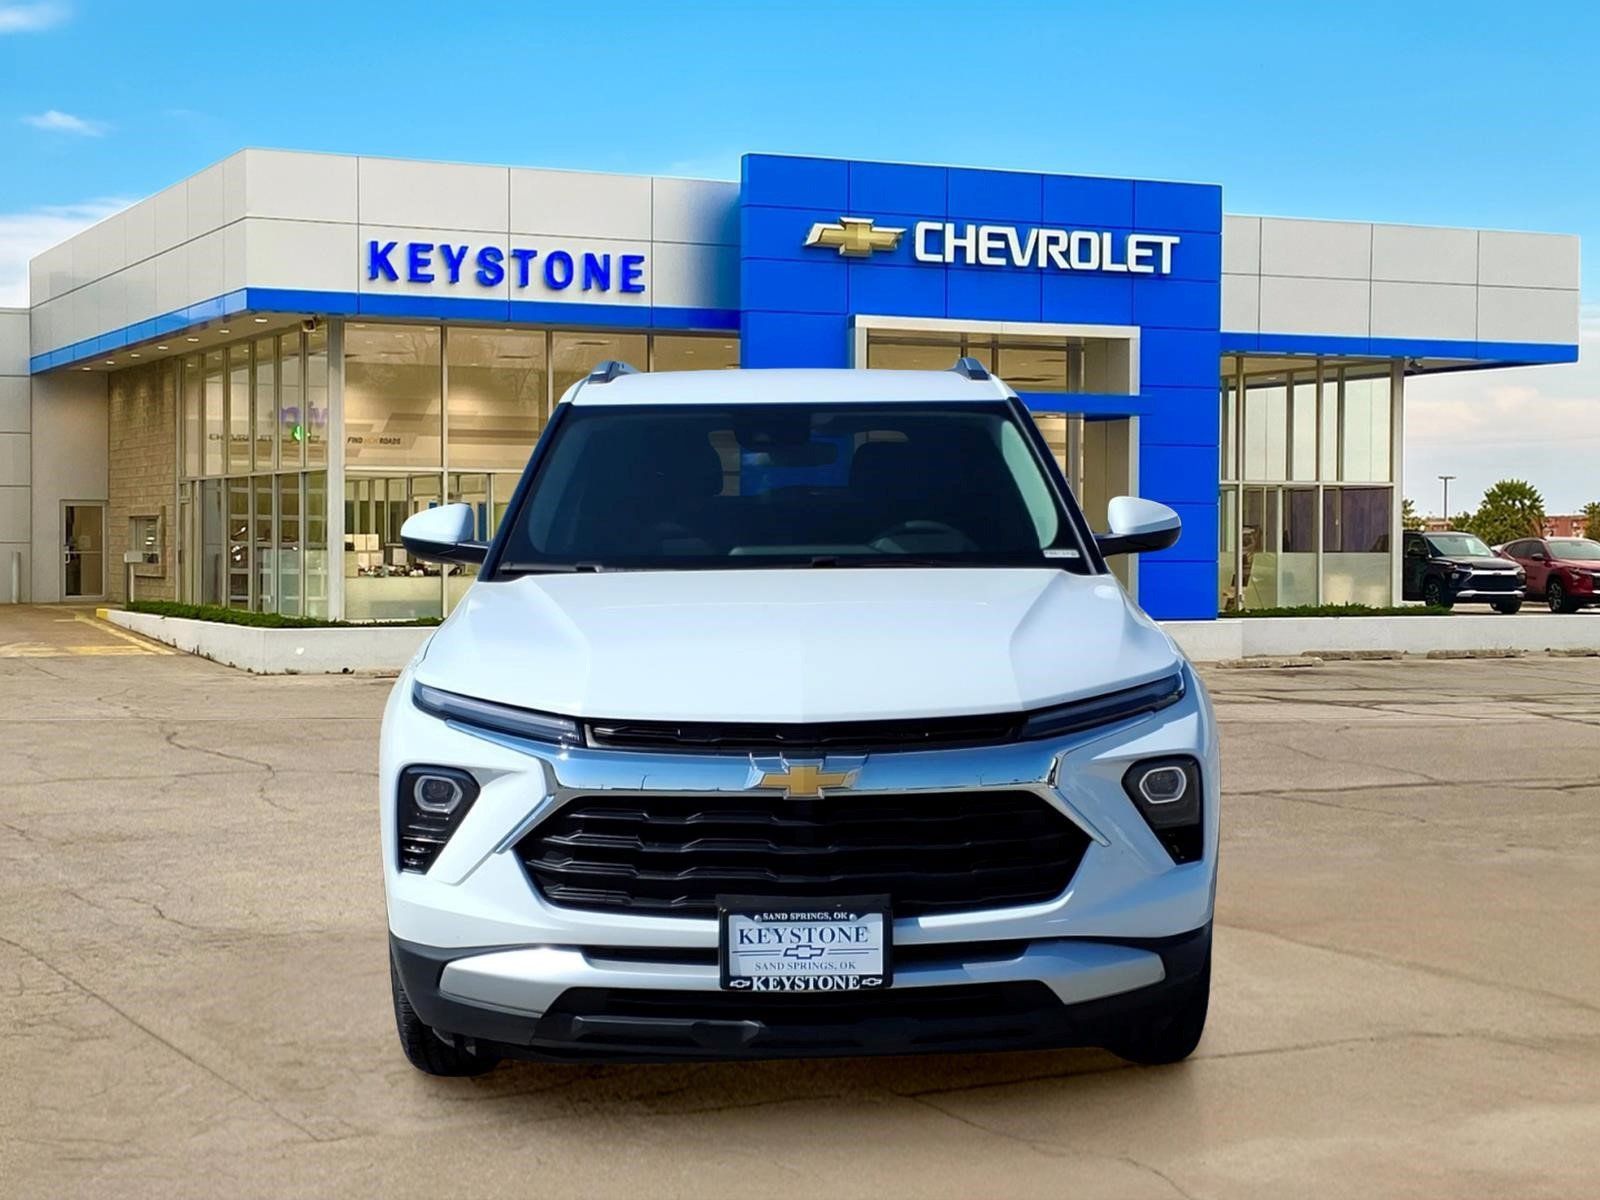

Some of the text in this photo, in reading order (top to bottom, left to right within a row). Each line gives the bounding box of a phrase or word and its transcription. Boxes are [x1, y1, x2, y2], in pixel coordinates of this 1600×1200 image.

[914, 220, 1180, 274] CHEVROLET
[367, 240, 646, 293] KEYSTONE
[763, 911, 849, 921] SAND SPRINGS, OK
[739, 926, 869, 945] KEYSTONE
[755, 961, 856, 971] SAND SPRINGS, OK
[752, 975, 861, 991] KEYSTONE
